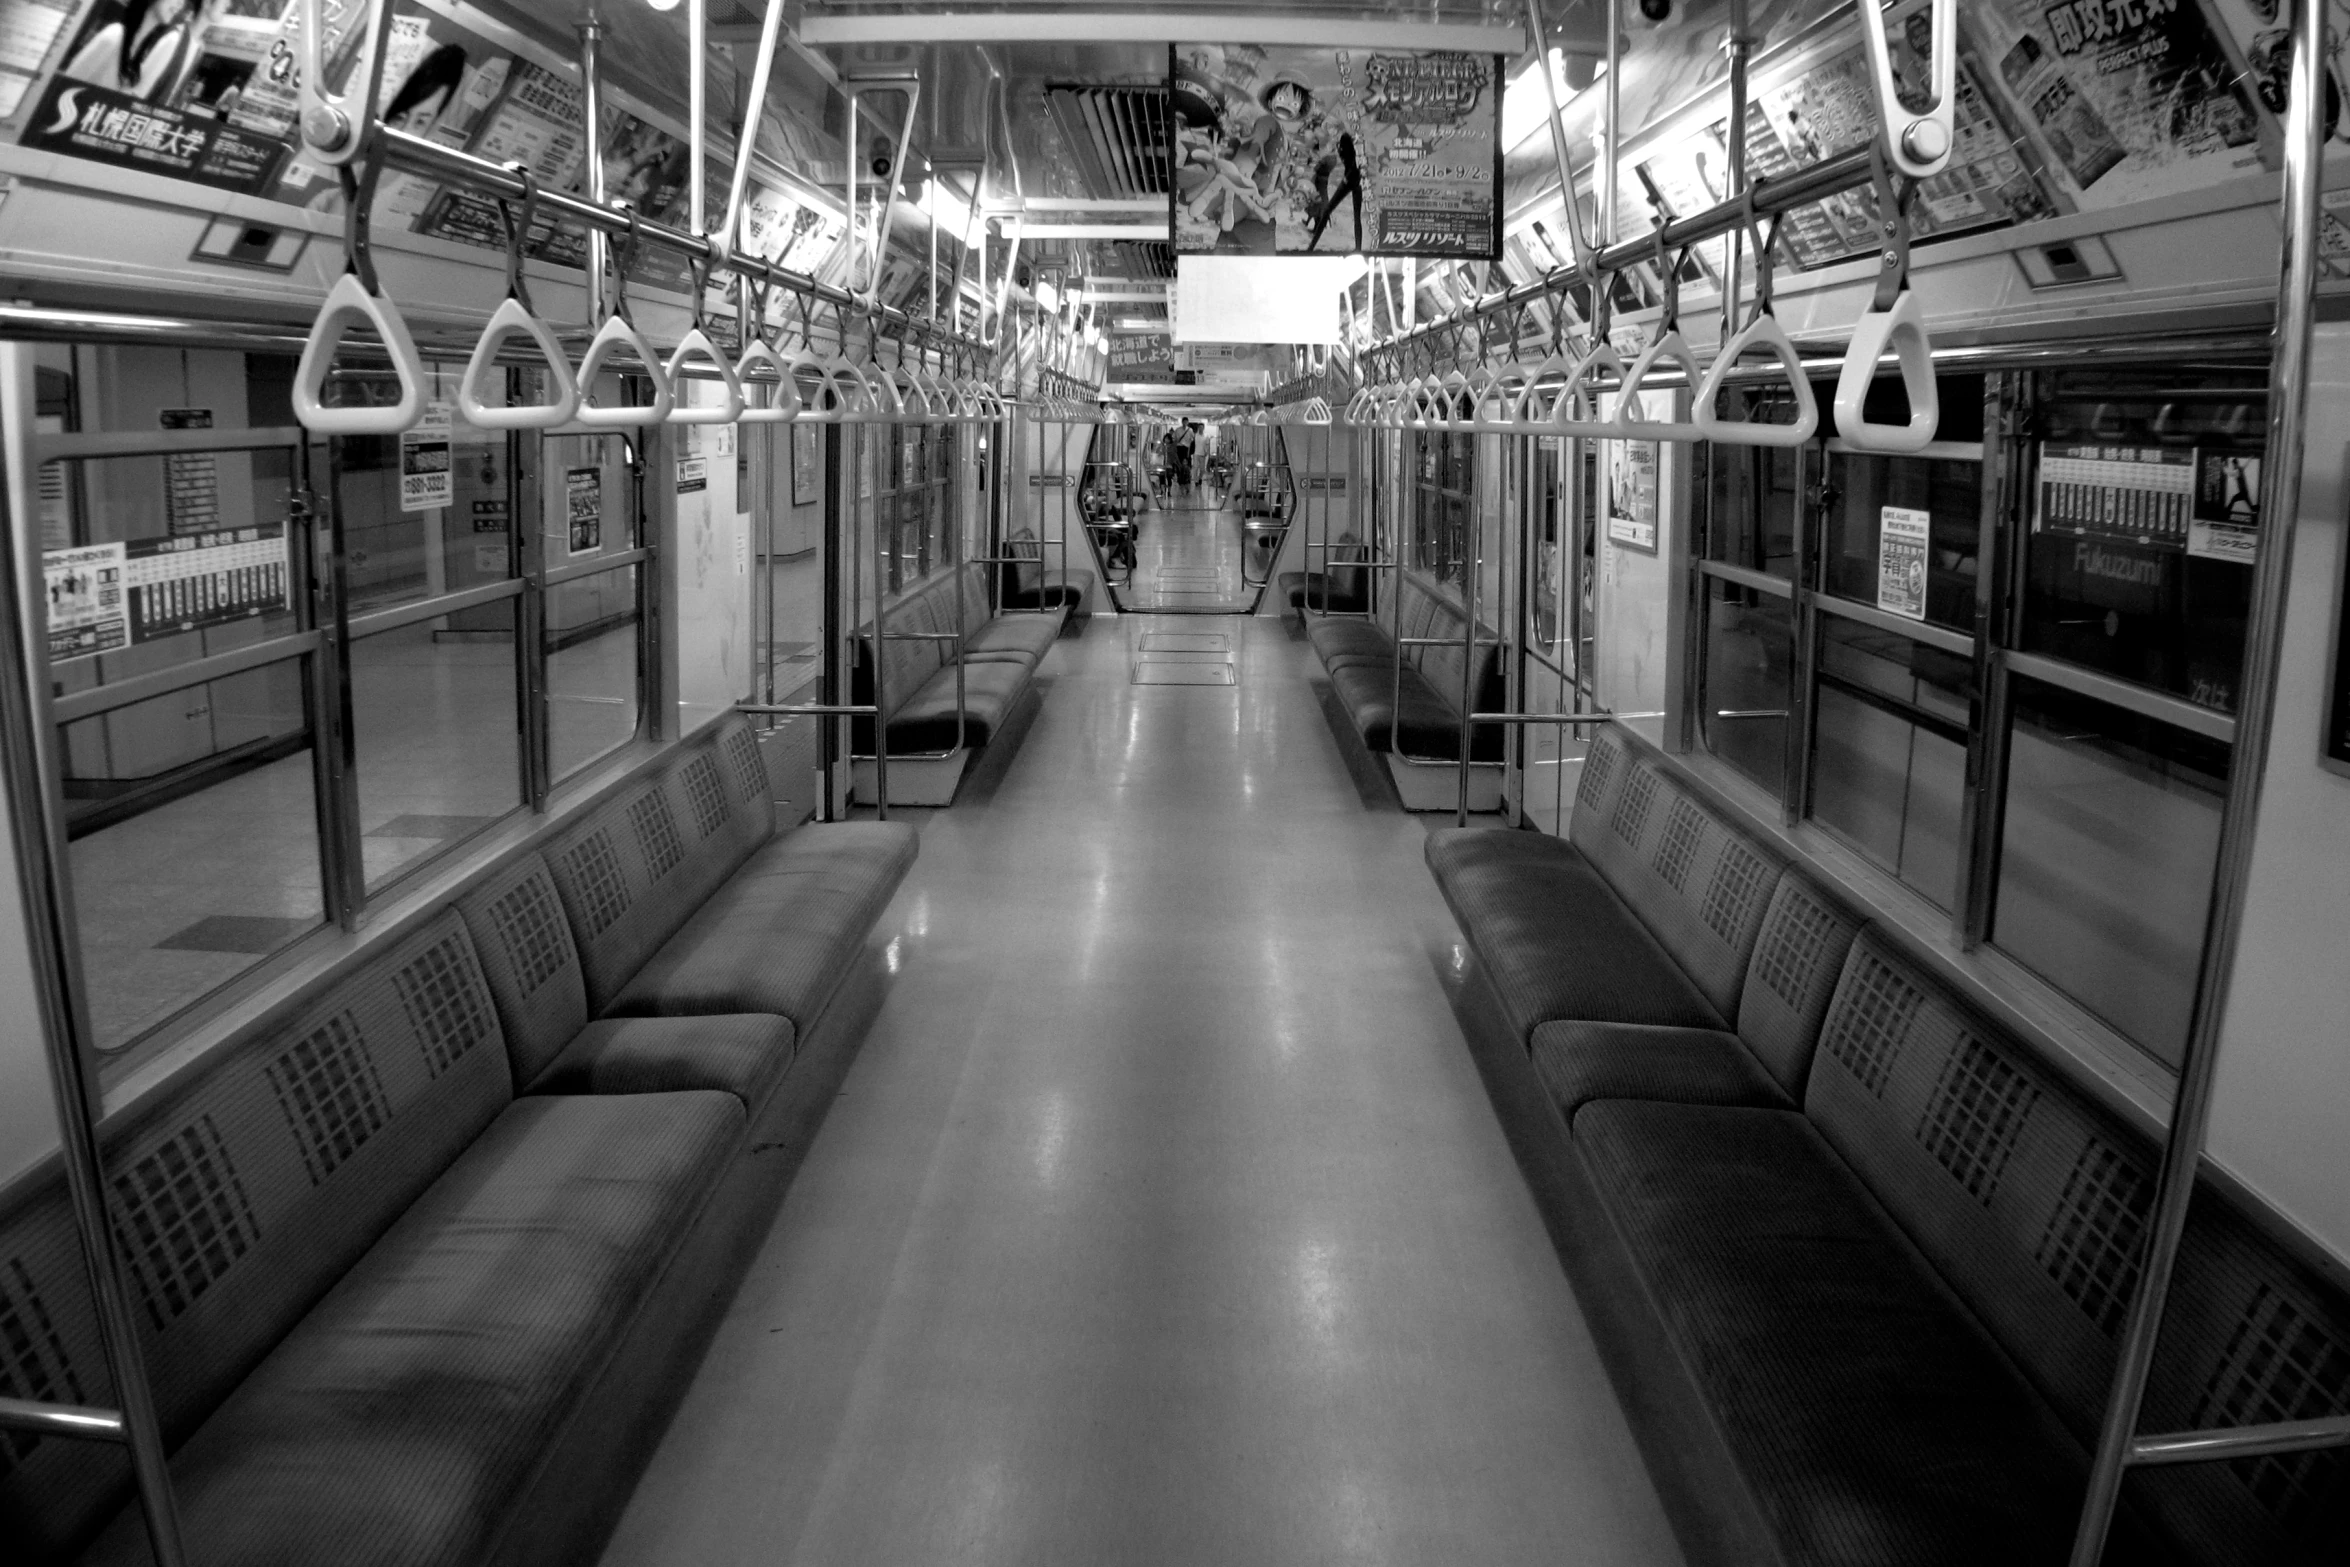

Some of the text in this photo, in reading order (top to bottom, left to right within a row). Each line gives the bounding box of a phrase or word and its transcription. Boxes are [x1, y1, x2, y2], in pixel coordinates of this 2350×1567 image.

[80, 101, 207, 159] 札幌国際大学
[1383, 167, 1404, 177] 2012
[1110, 334, 1161, 351] 北海道で
[2073, 542, 2164, 587] Fukuzumi
